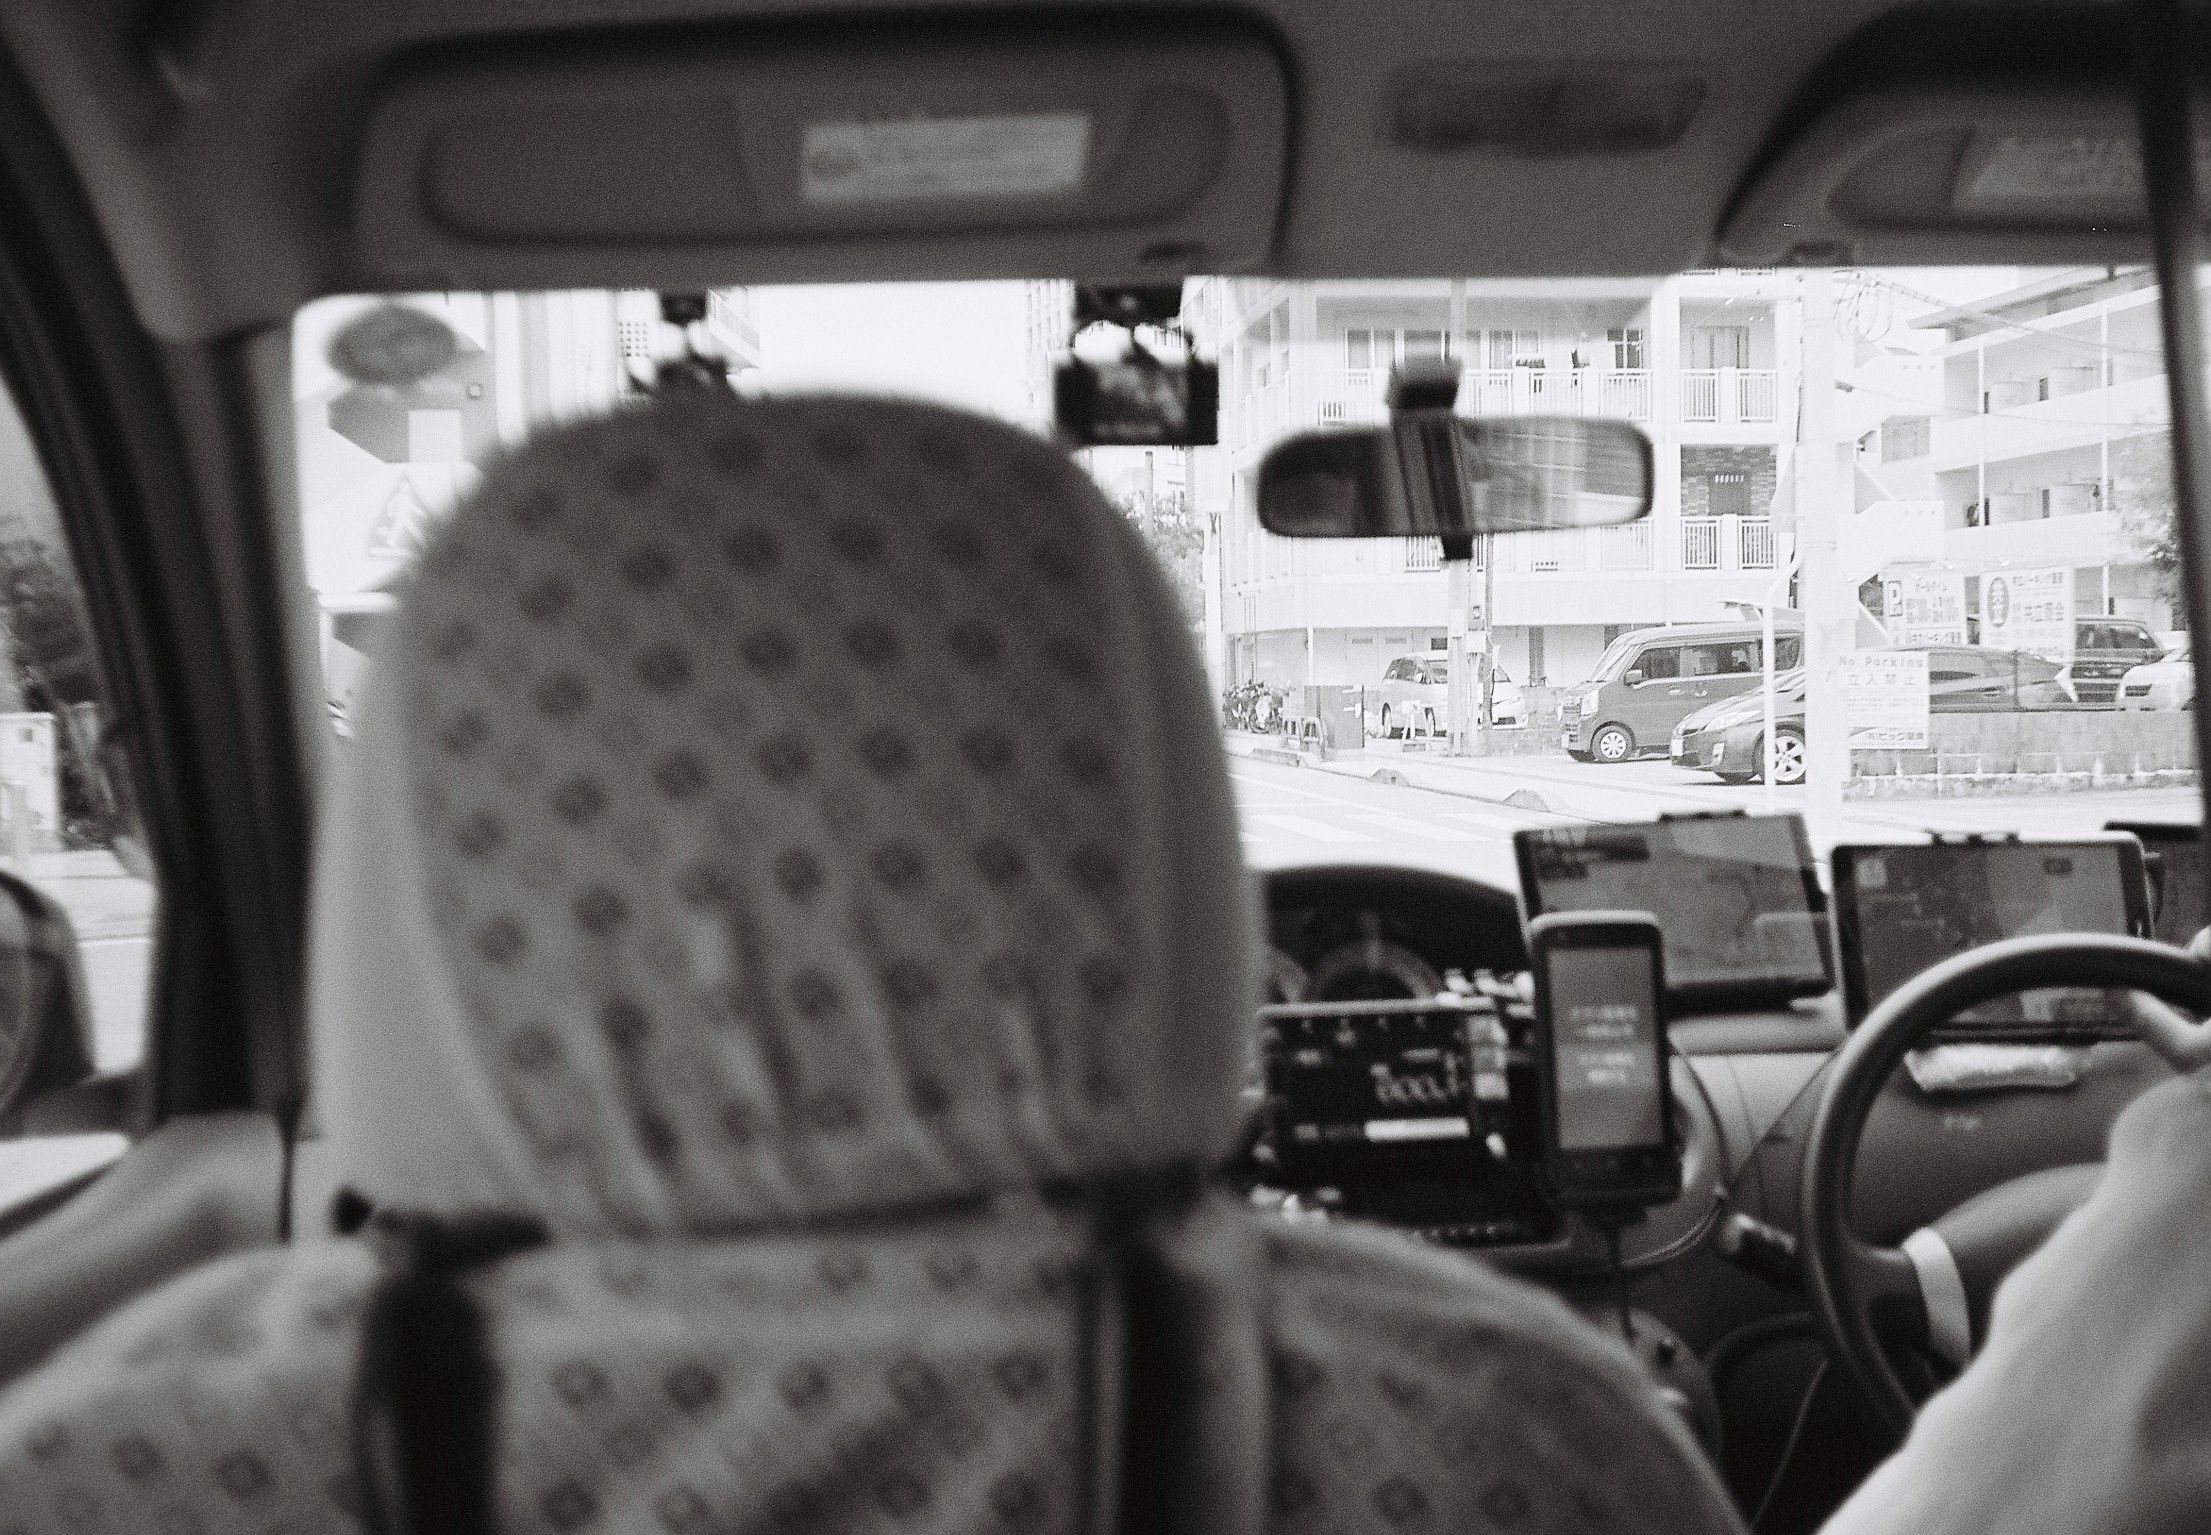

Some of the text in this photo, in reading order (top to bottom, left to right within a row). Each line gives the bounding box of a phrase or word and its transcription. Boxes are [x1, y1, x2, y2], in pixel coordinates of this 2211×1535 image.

[1839, 656, 1923, 668] No Parking
[1847, 673, 1916, 686] 立入禁止
